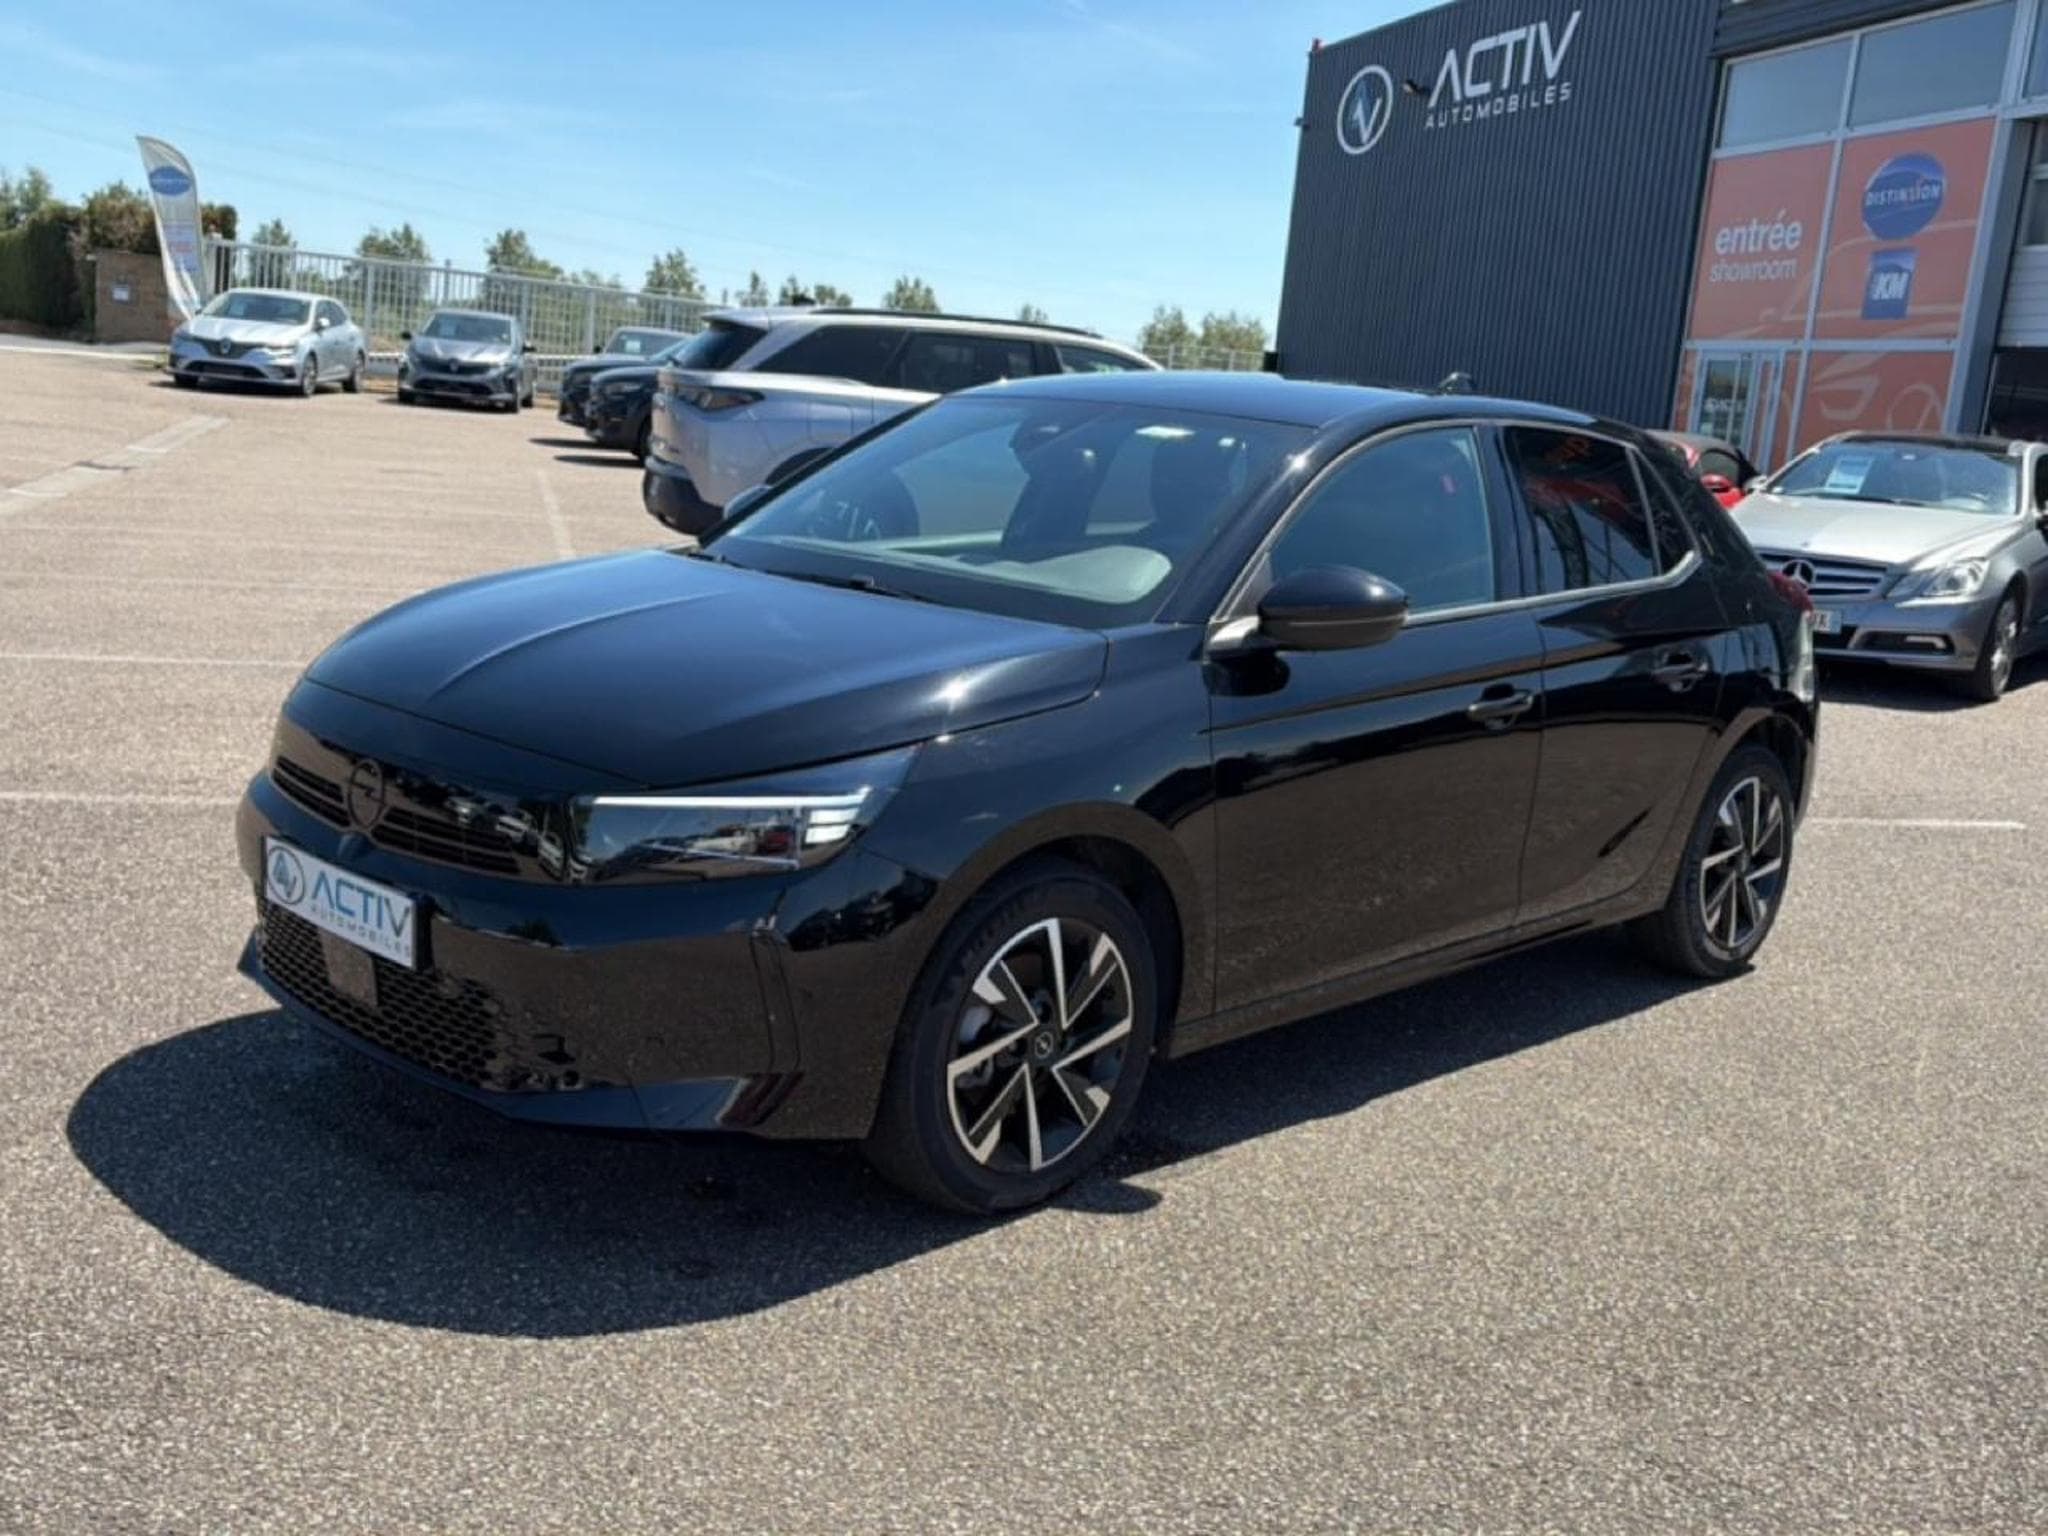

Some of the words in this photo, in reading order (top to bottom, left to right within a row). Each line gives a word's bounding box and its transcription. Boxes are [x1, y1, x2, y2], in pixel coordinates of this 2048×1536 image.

[1428, 10, 1581, 108] ACTIV
[1424, 83, 1572, 129] AUTOMOBILES
[1715, 209, 1802, 255] entrée
[1709, 258, 1797, 282] showroom
[312, 870, 411, 938] ACTIV
